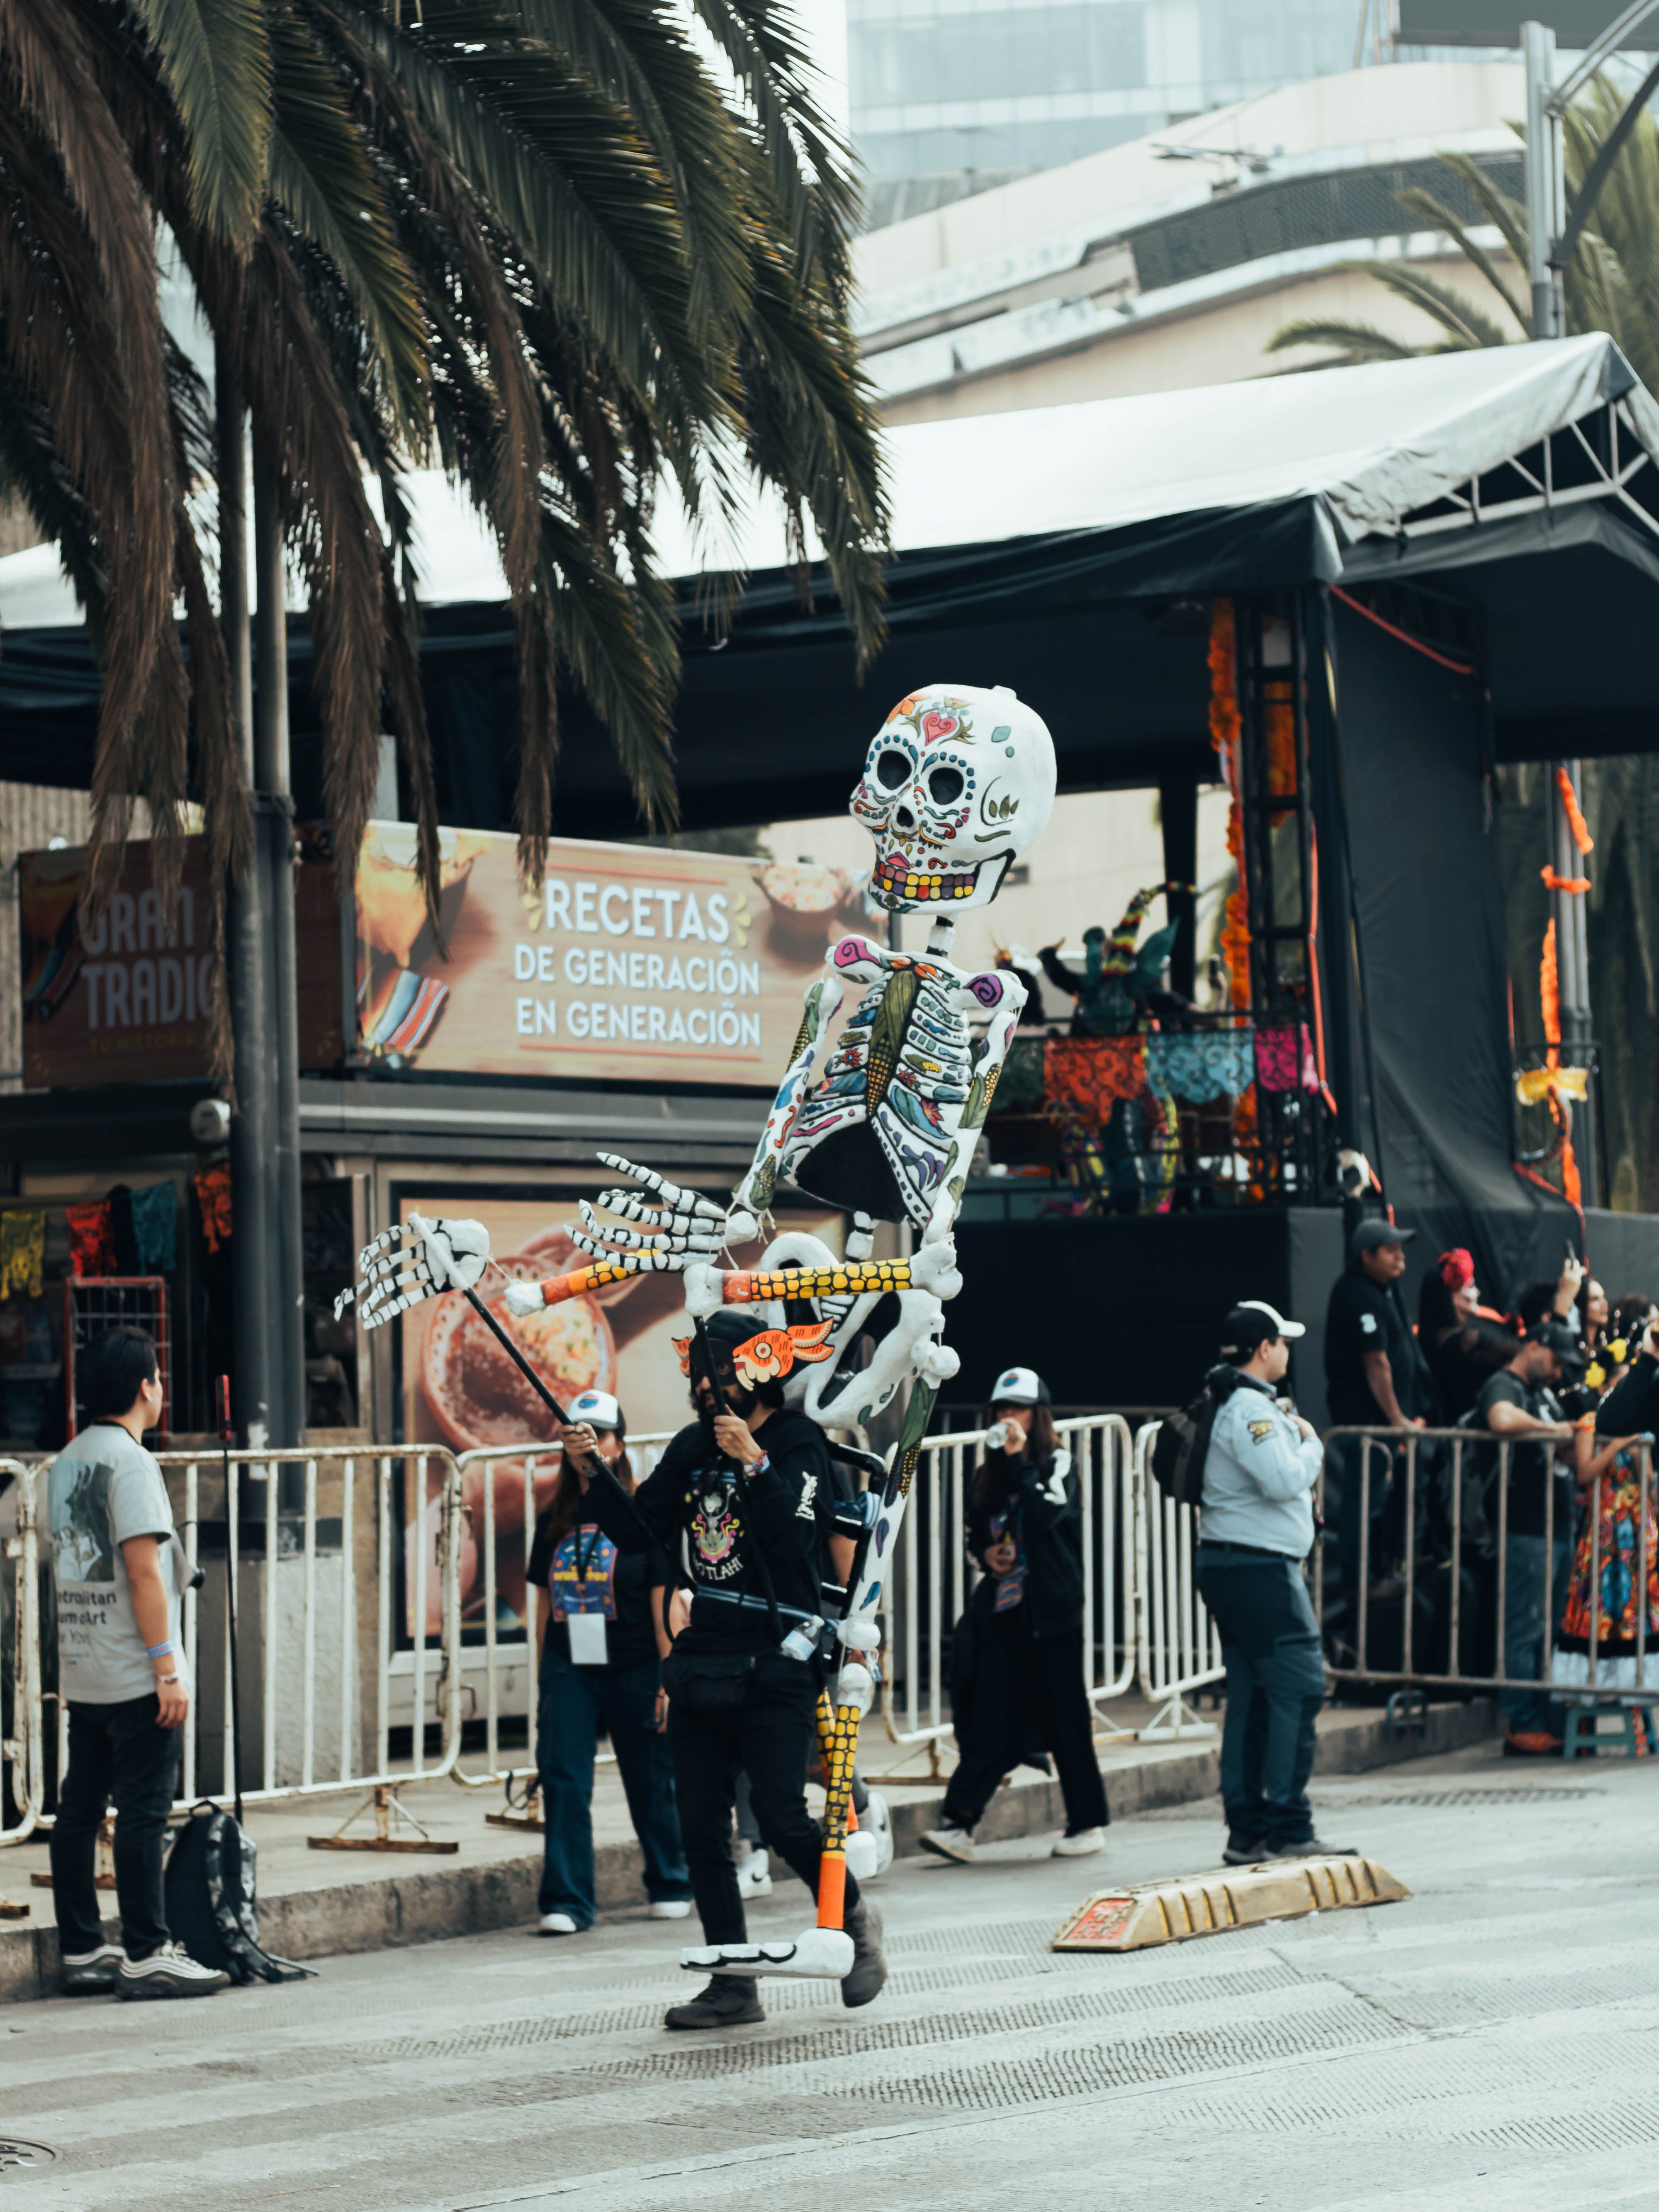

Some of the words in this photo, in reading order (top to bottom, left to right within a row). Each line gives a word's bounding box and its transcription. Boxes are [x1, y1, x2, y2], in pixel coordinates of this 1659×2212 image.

[545, 878, 730, 944] RECETAS
[514, 943, 555, 982] DE
[516, 997, 557, 1036] EN
